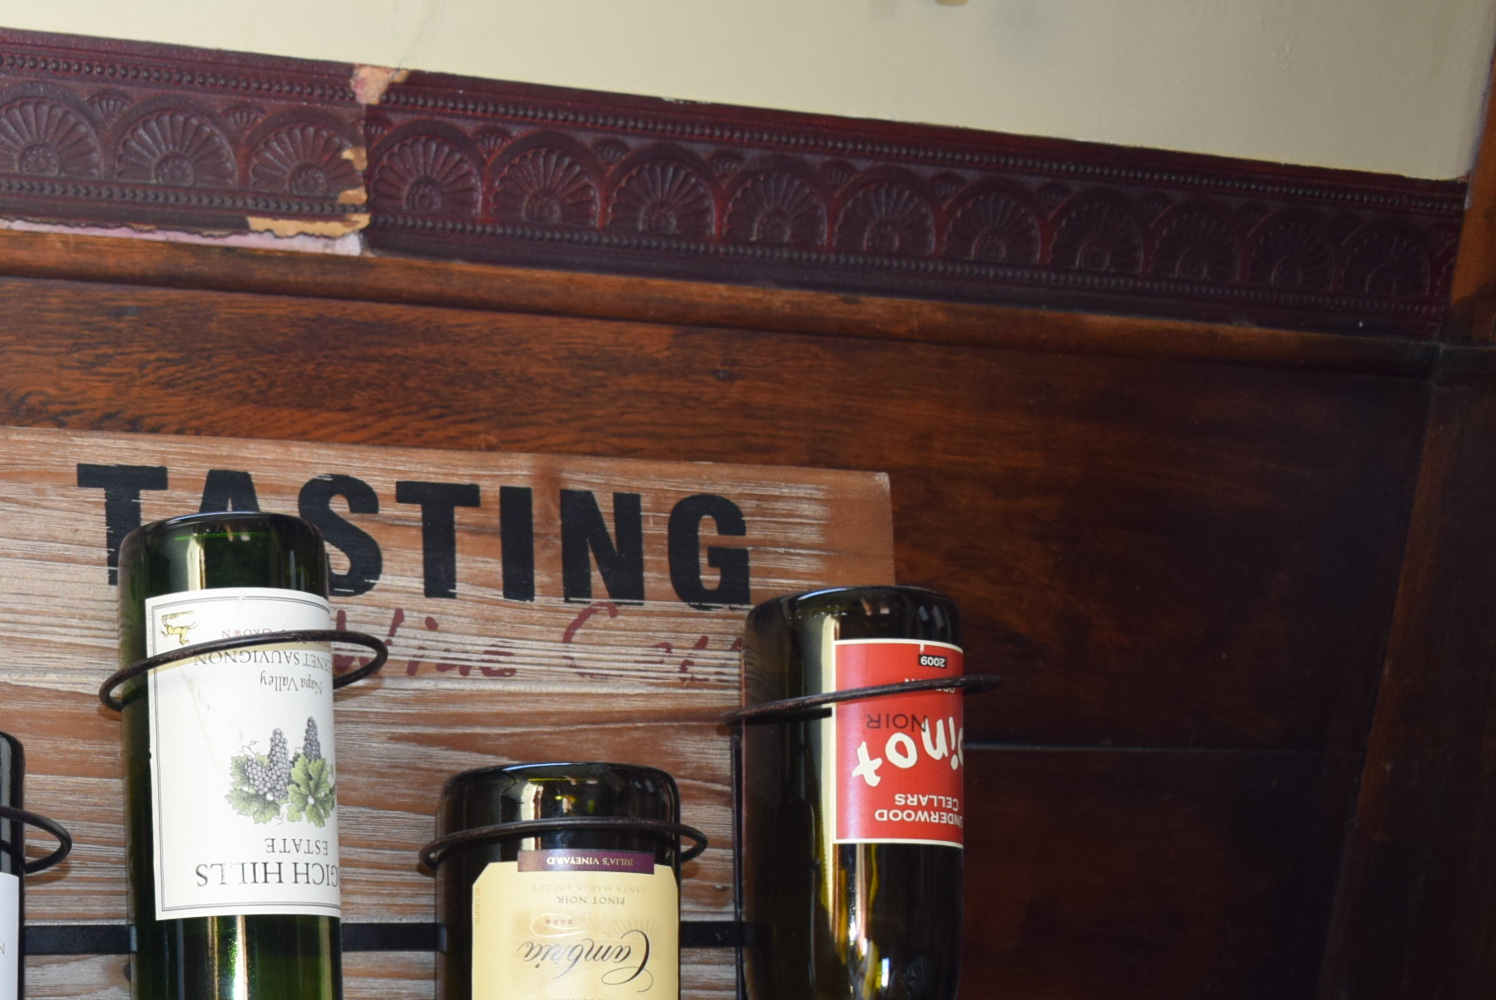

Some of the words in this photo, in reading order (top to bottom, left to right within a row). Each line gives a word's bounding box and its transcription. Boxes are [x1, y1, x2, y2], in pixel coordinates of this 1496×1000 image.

[194, 649, 300, 666] SAUVIGNON
[920, 656, 945, 667] 2009
[260, 671, 298, 692] Valley
[301, 675, 323, 695] Napa
[866, 714, 926, 732] NOIR
[895, 794, 959, 811] CELLARS
[265, 838, 328, 855] ESTATE
[547, 857, 599, 865] VINEYARD
[602, 857, 633, 866] JULIA'S
[195, 861, 284, 886] HILLS
[293, 862, 341, 886] GICH
[556, 896, 586, 904] NOIR
[592, 897, 625, 905] PINOT
[517, 930, 653, 992] Cambria
